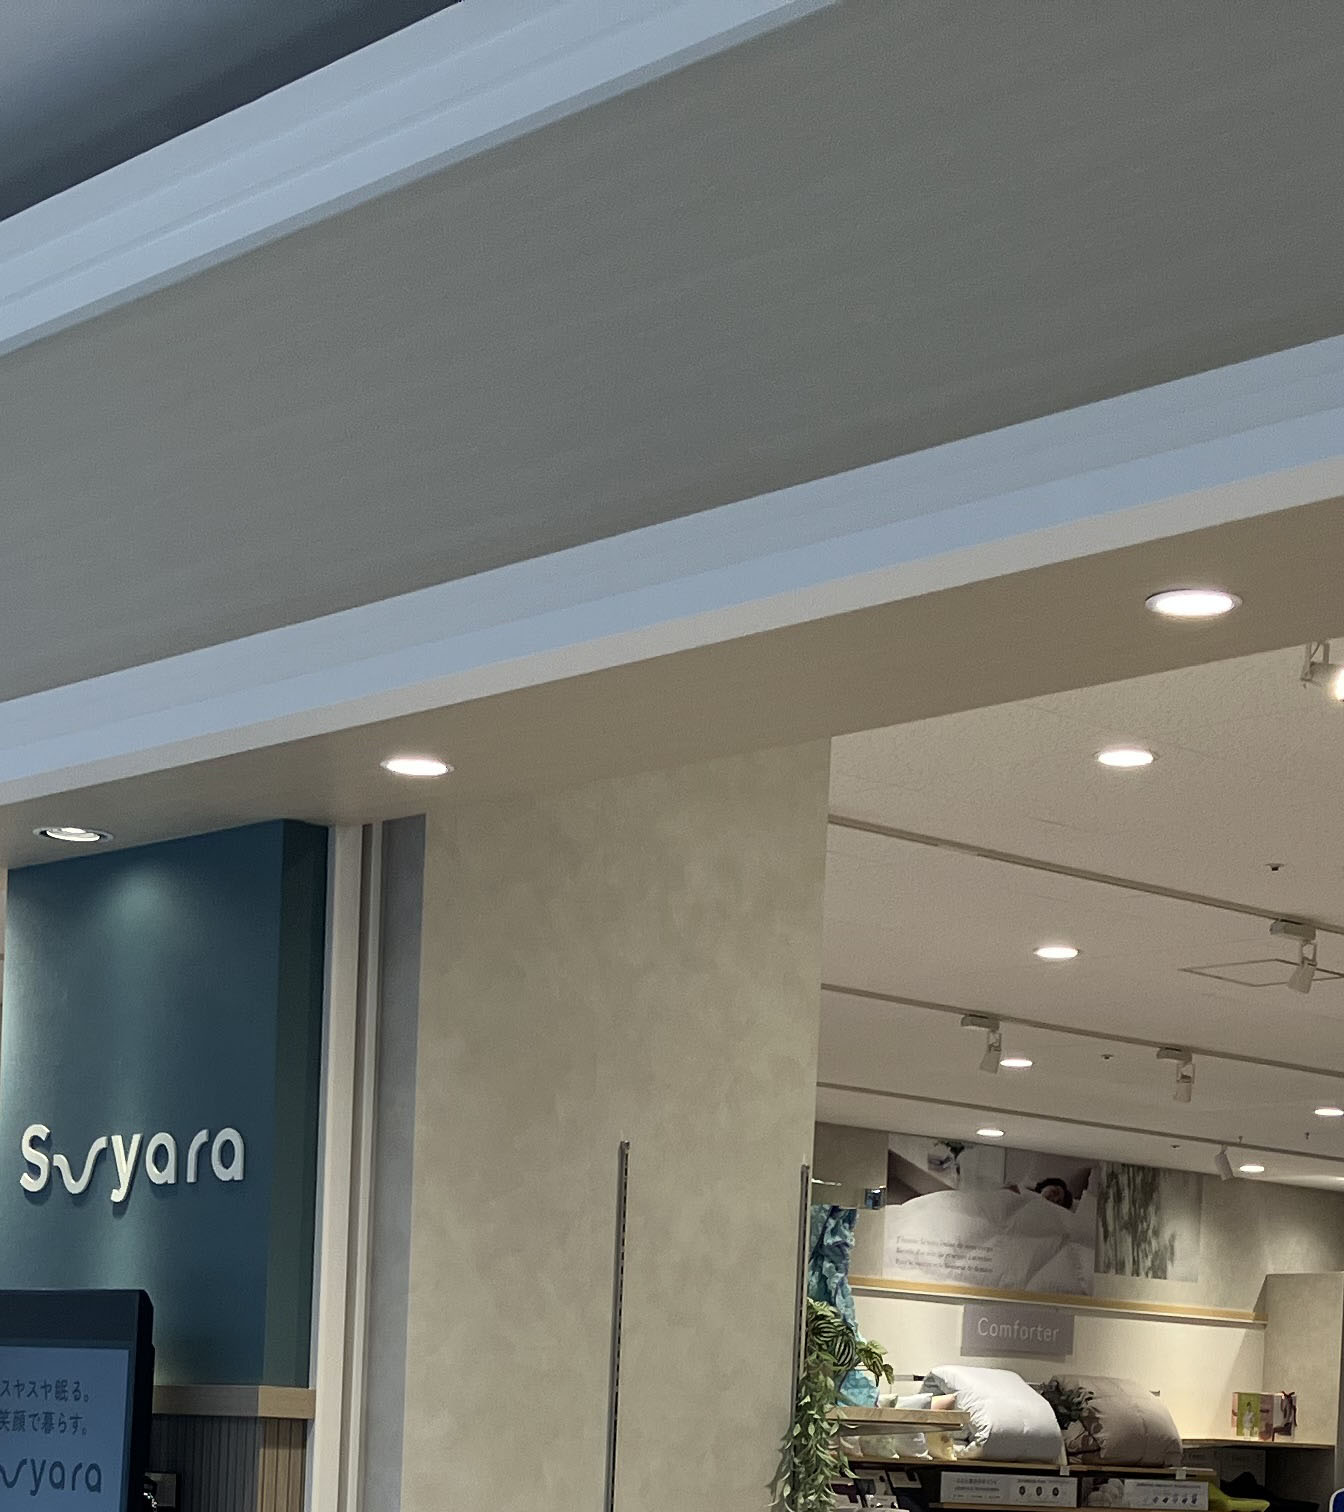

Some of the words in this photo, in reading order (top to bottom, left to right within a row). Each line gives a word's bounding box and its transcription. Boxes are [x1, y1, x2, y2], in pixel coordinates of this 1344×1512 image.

[19, 1123, 246, 1203] Suyara
[977, 1317, 1059, 1341] Comforter
[0, 1379, 89, 1402] スヤスヤ眠る。
